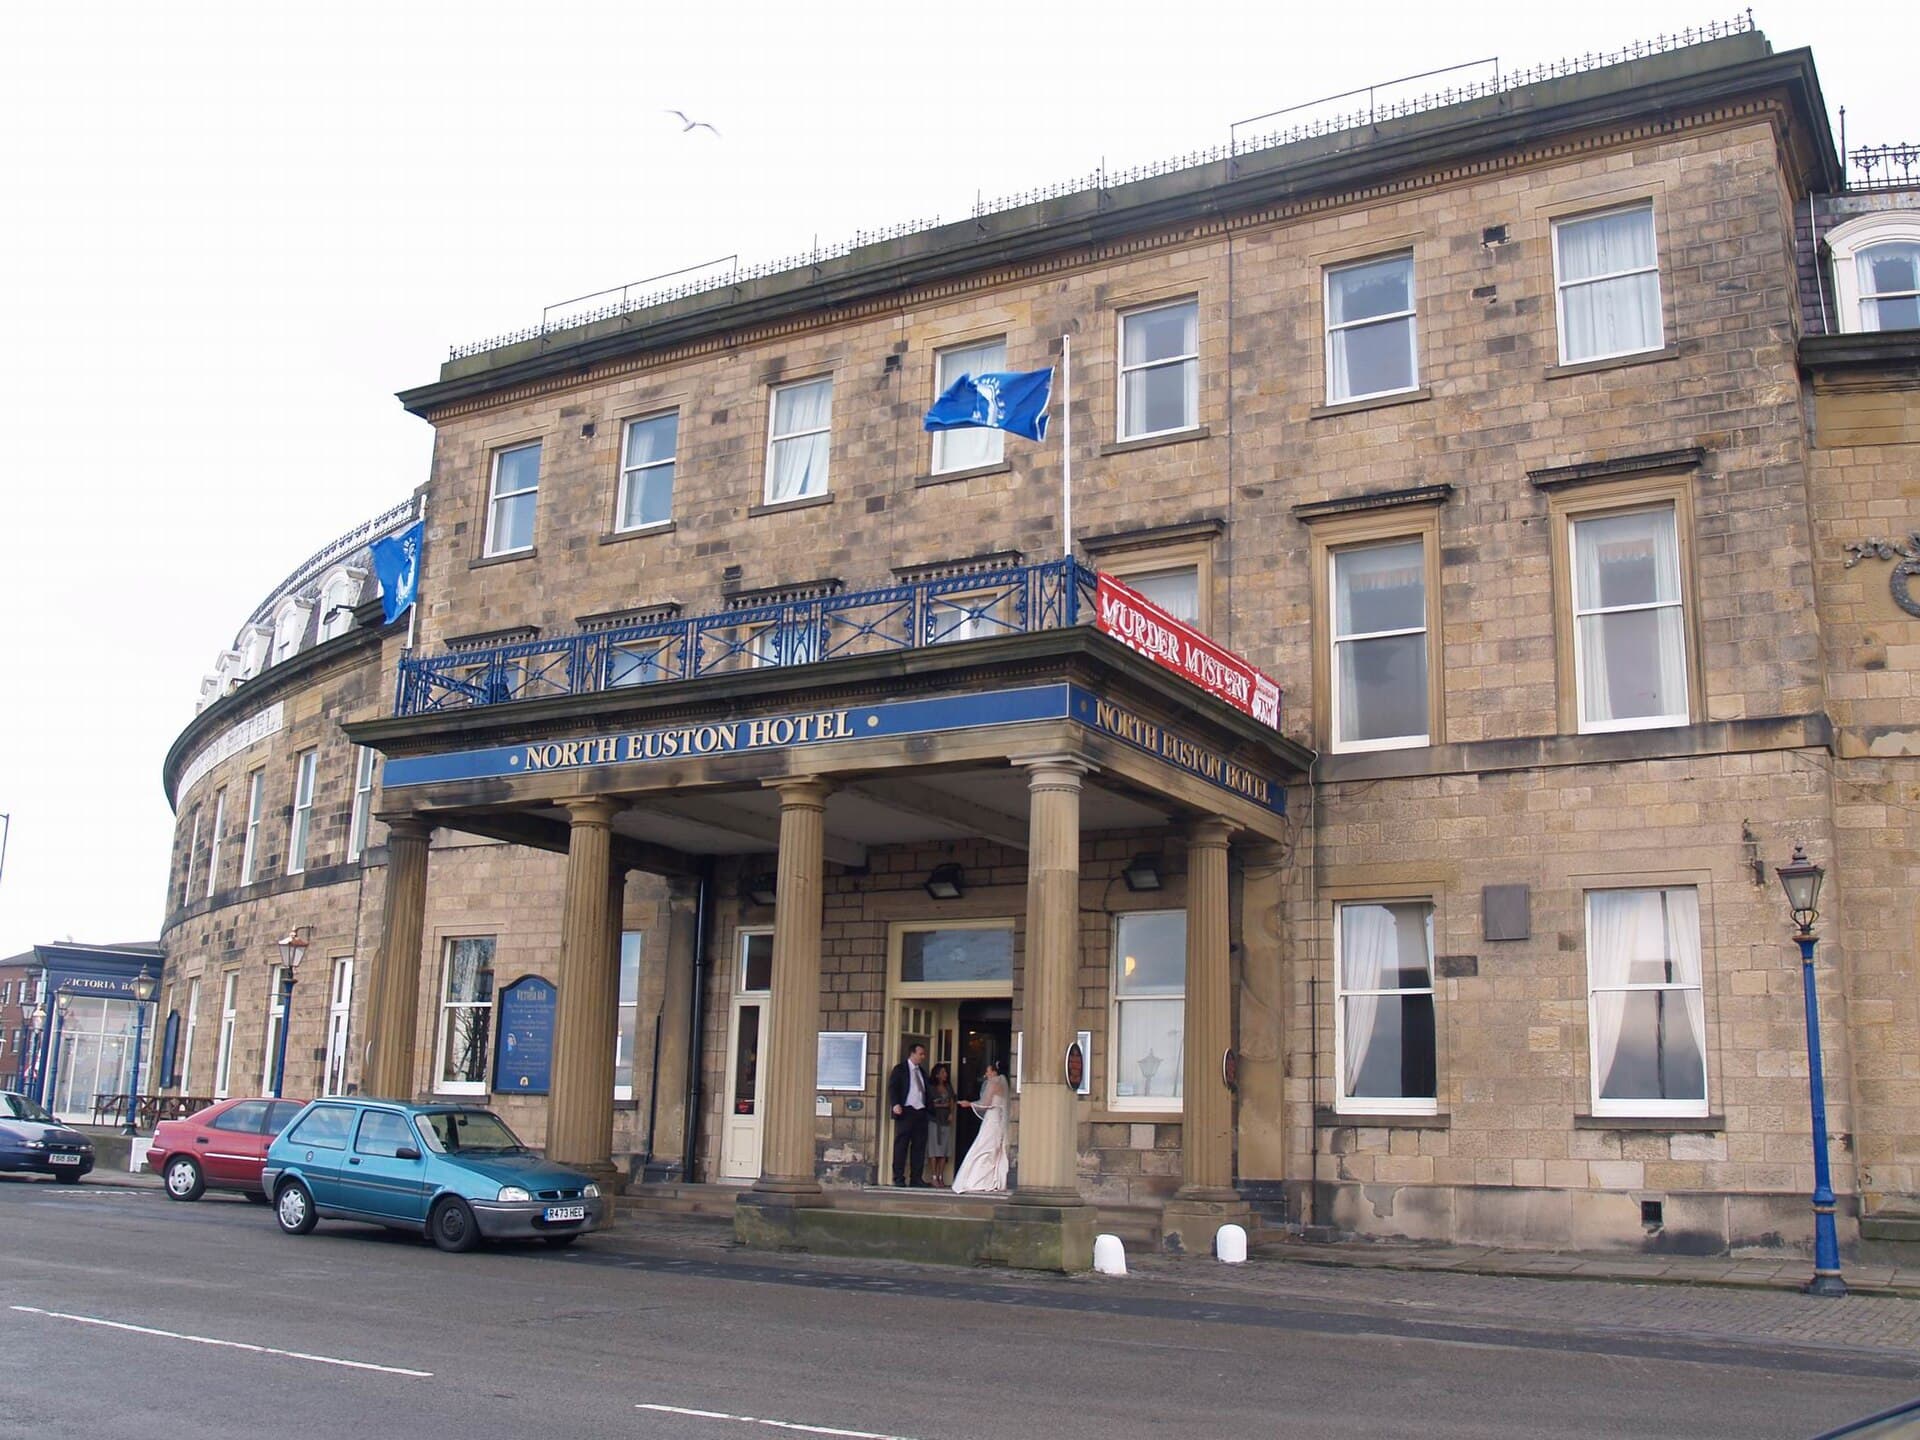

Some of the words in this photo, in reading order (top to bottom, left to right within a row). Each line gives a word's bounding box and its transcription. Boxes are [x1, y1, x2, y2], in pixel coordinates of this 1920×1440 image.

[1101, 591, 1181, 666] MURDER
[1184, 641, 1251, 706] MYSTERY
[524, 737, 618, 771] NORTH
[625, 723, 739, 760] EUSTON
[747, 711, 854, 748] HOTEL
[1095, 698, 1159, 753] NORTH
[1161, 730, 1222, 782] EUSTON
[1225, 760, 1272, 804] HOTEL
[121, 982, 136, 991] BA
[549, 1208, 568, 1219] R473
